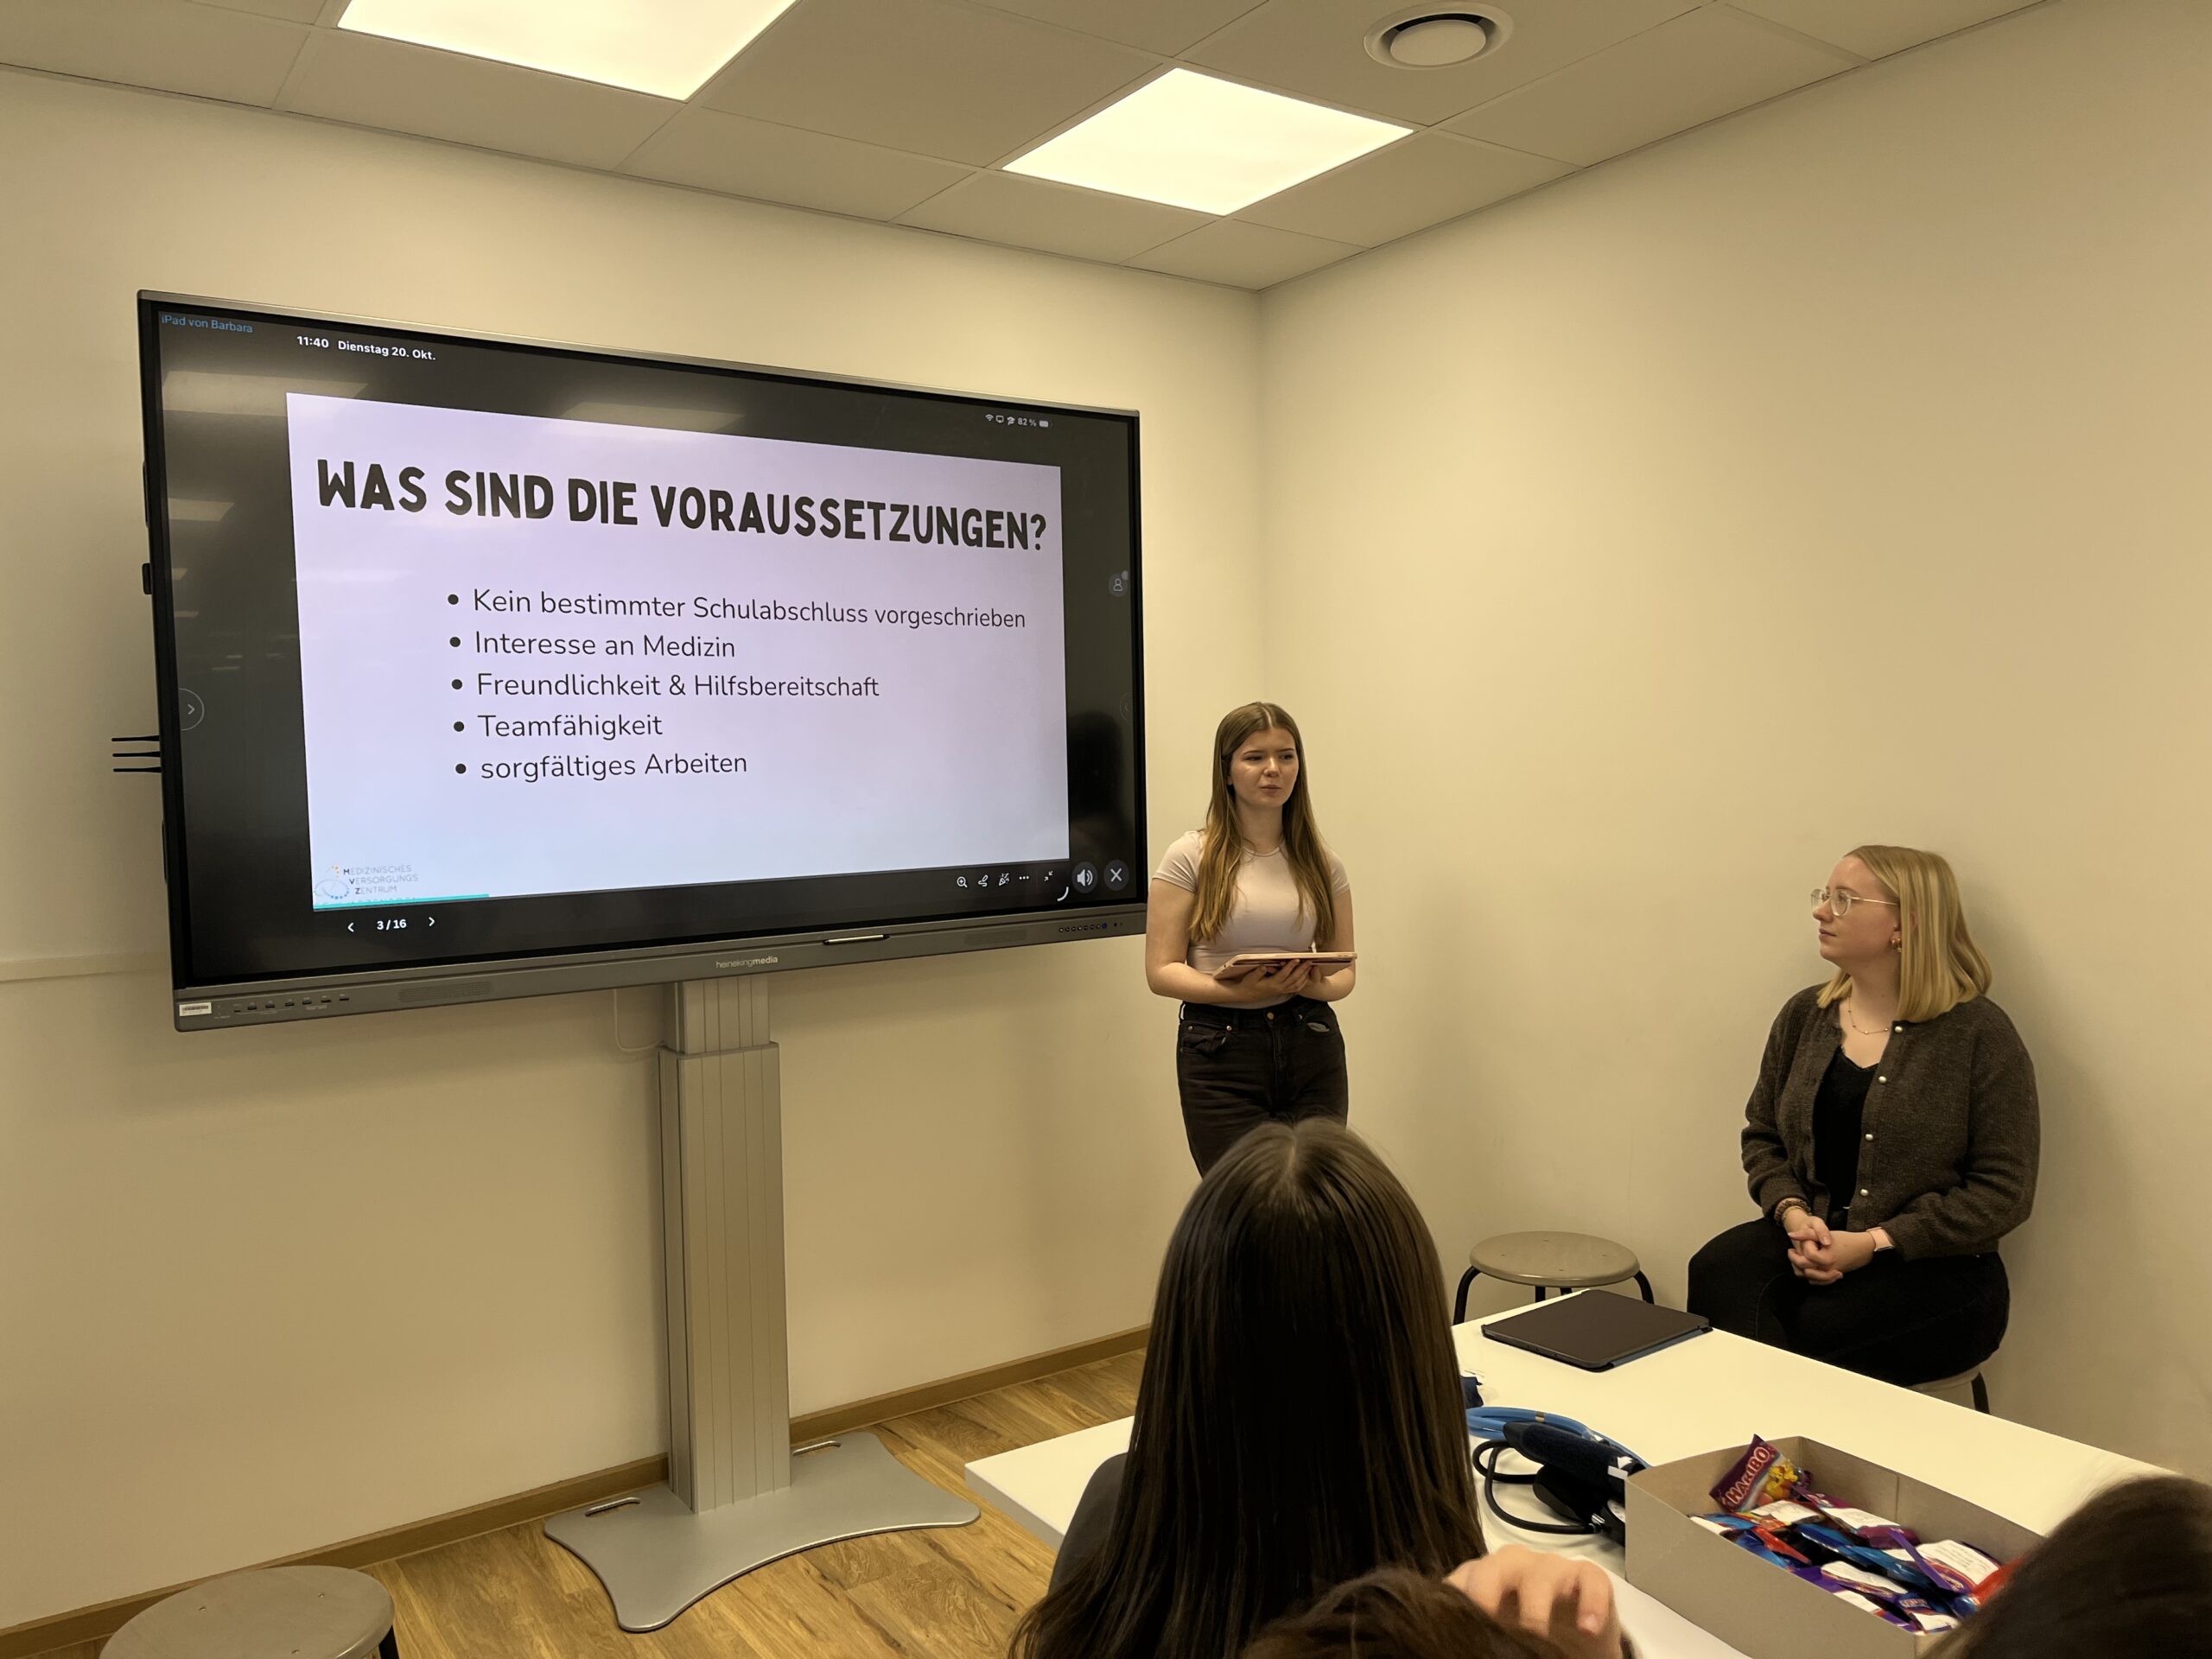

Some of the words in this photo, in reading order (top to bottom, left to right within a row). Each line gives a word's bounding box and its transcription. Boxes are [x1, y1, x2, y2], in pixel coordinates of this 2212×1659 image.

[162, 315, 185, 327] iPad
[188, 320, 208, 328] von
[212, 320, 253, 333] Barbara
[296, 335, 329, 348] 11:40
[338, 340, 389, 357] Dienstag
[391, 347, 410, 359] 20.
[412, 349, 436, 360] Okt.
[317, 459, 427, 512] WAS
[445, 470, 554, 518] SIND
[568, 478, 638, 525] DIE
[650, 485, 1046, 550] VORAUSSETZUNGEN?
[474, 588, 531, 612] Kein
[541, 591, 686, 617] bestimmter
[694, 596, 868, 623] Schulabschluss
[874, 607, 1026, 629] vorgeschrieben
[476, 631, 596, 655] Interesse
[605, 639, 634, 655] an
[644, 634, 735, 658] Medizin
[478, 673, 662, 696] Freundlichkeit
[669, 675, 686, 696] &
[695, 674, 880, 696] Hilfsbereitschaft
[477, 714, 664, 741] Teamfähigkeit
[480, 754, 636, 783] sorgfältiges
[645, 753, 747, 776] Arbeiten
[343, 864, 412, 875] MEDIZINISCHES
[349, 874, 419, 885] VERSORGUNGS
[355, 886, 397, 894] ZENTRUM
[1725, 1446, 1770, 1504] HARIBO
